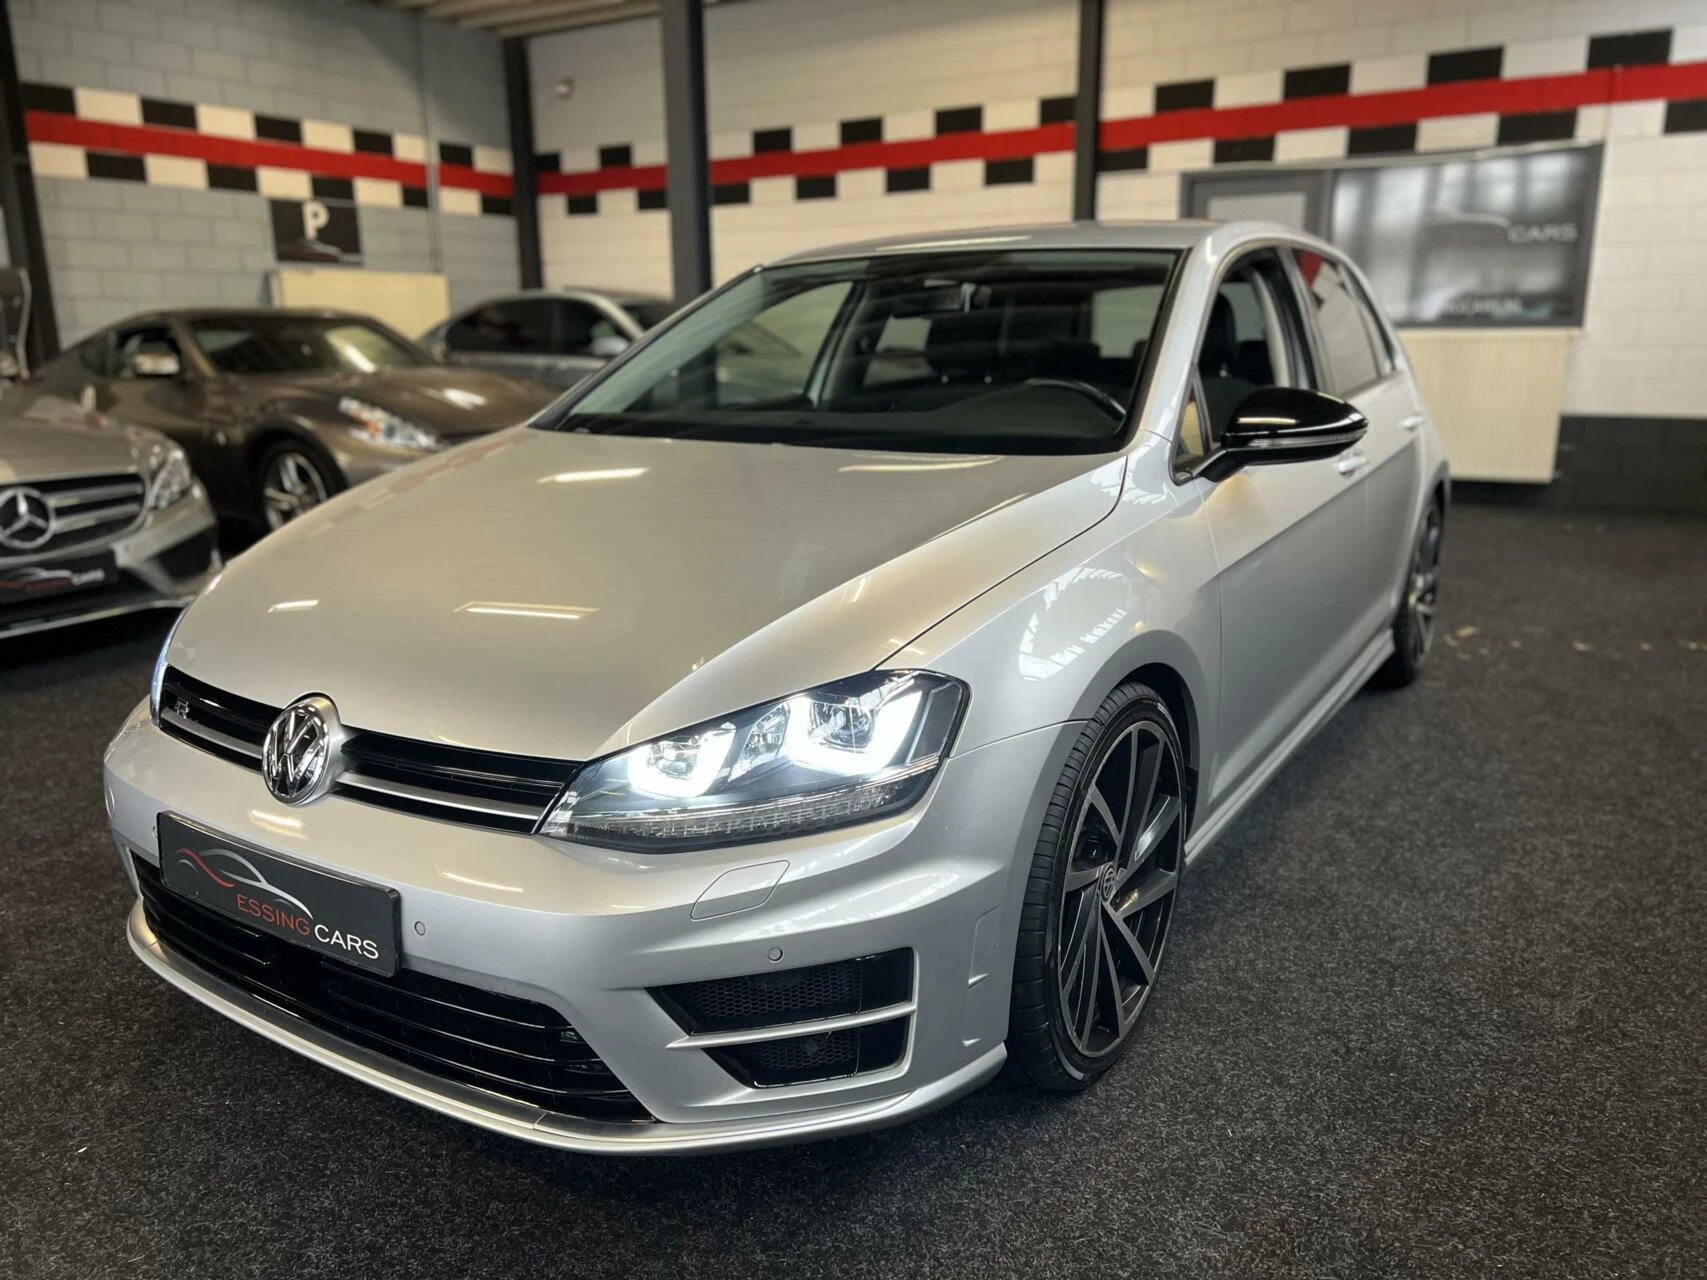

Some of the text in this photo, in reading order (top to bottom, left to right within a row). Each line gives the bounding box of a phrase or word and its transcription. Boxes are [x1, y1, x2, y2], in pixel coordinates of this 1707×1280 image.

[302, 200, 330, 241] P
[236, 894, 379, 960] ESSING CARS
